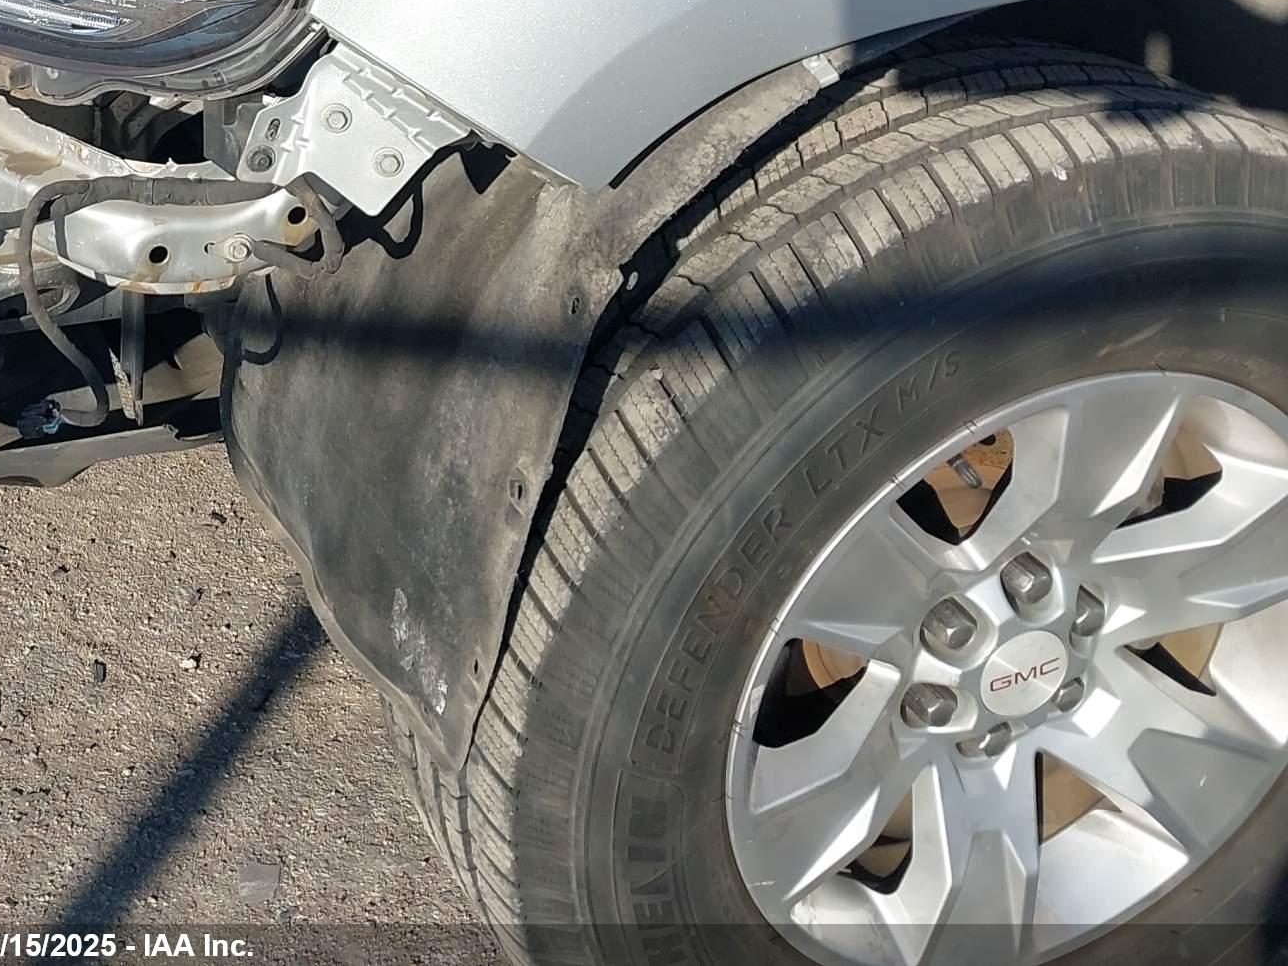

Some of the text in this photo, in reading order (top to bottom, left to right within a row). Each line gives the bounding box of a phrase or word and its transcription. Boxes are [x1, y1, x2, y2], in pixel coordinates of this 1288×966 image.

[646, 350, 960, 755] DEFENDER LTX M/S
[990, 657, 1061, 692] GMC
